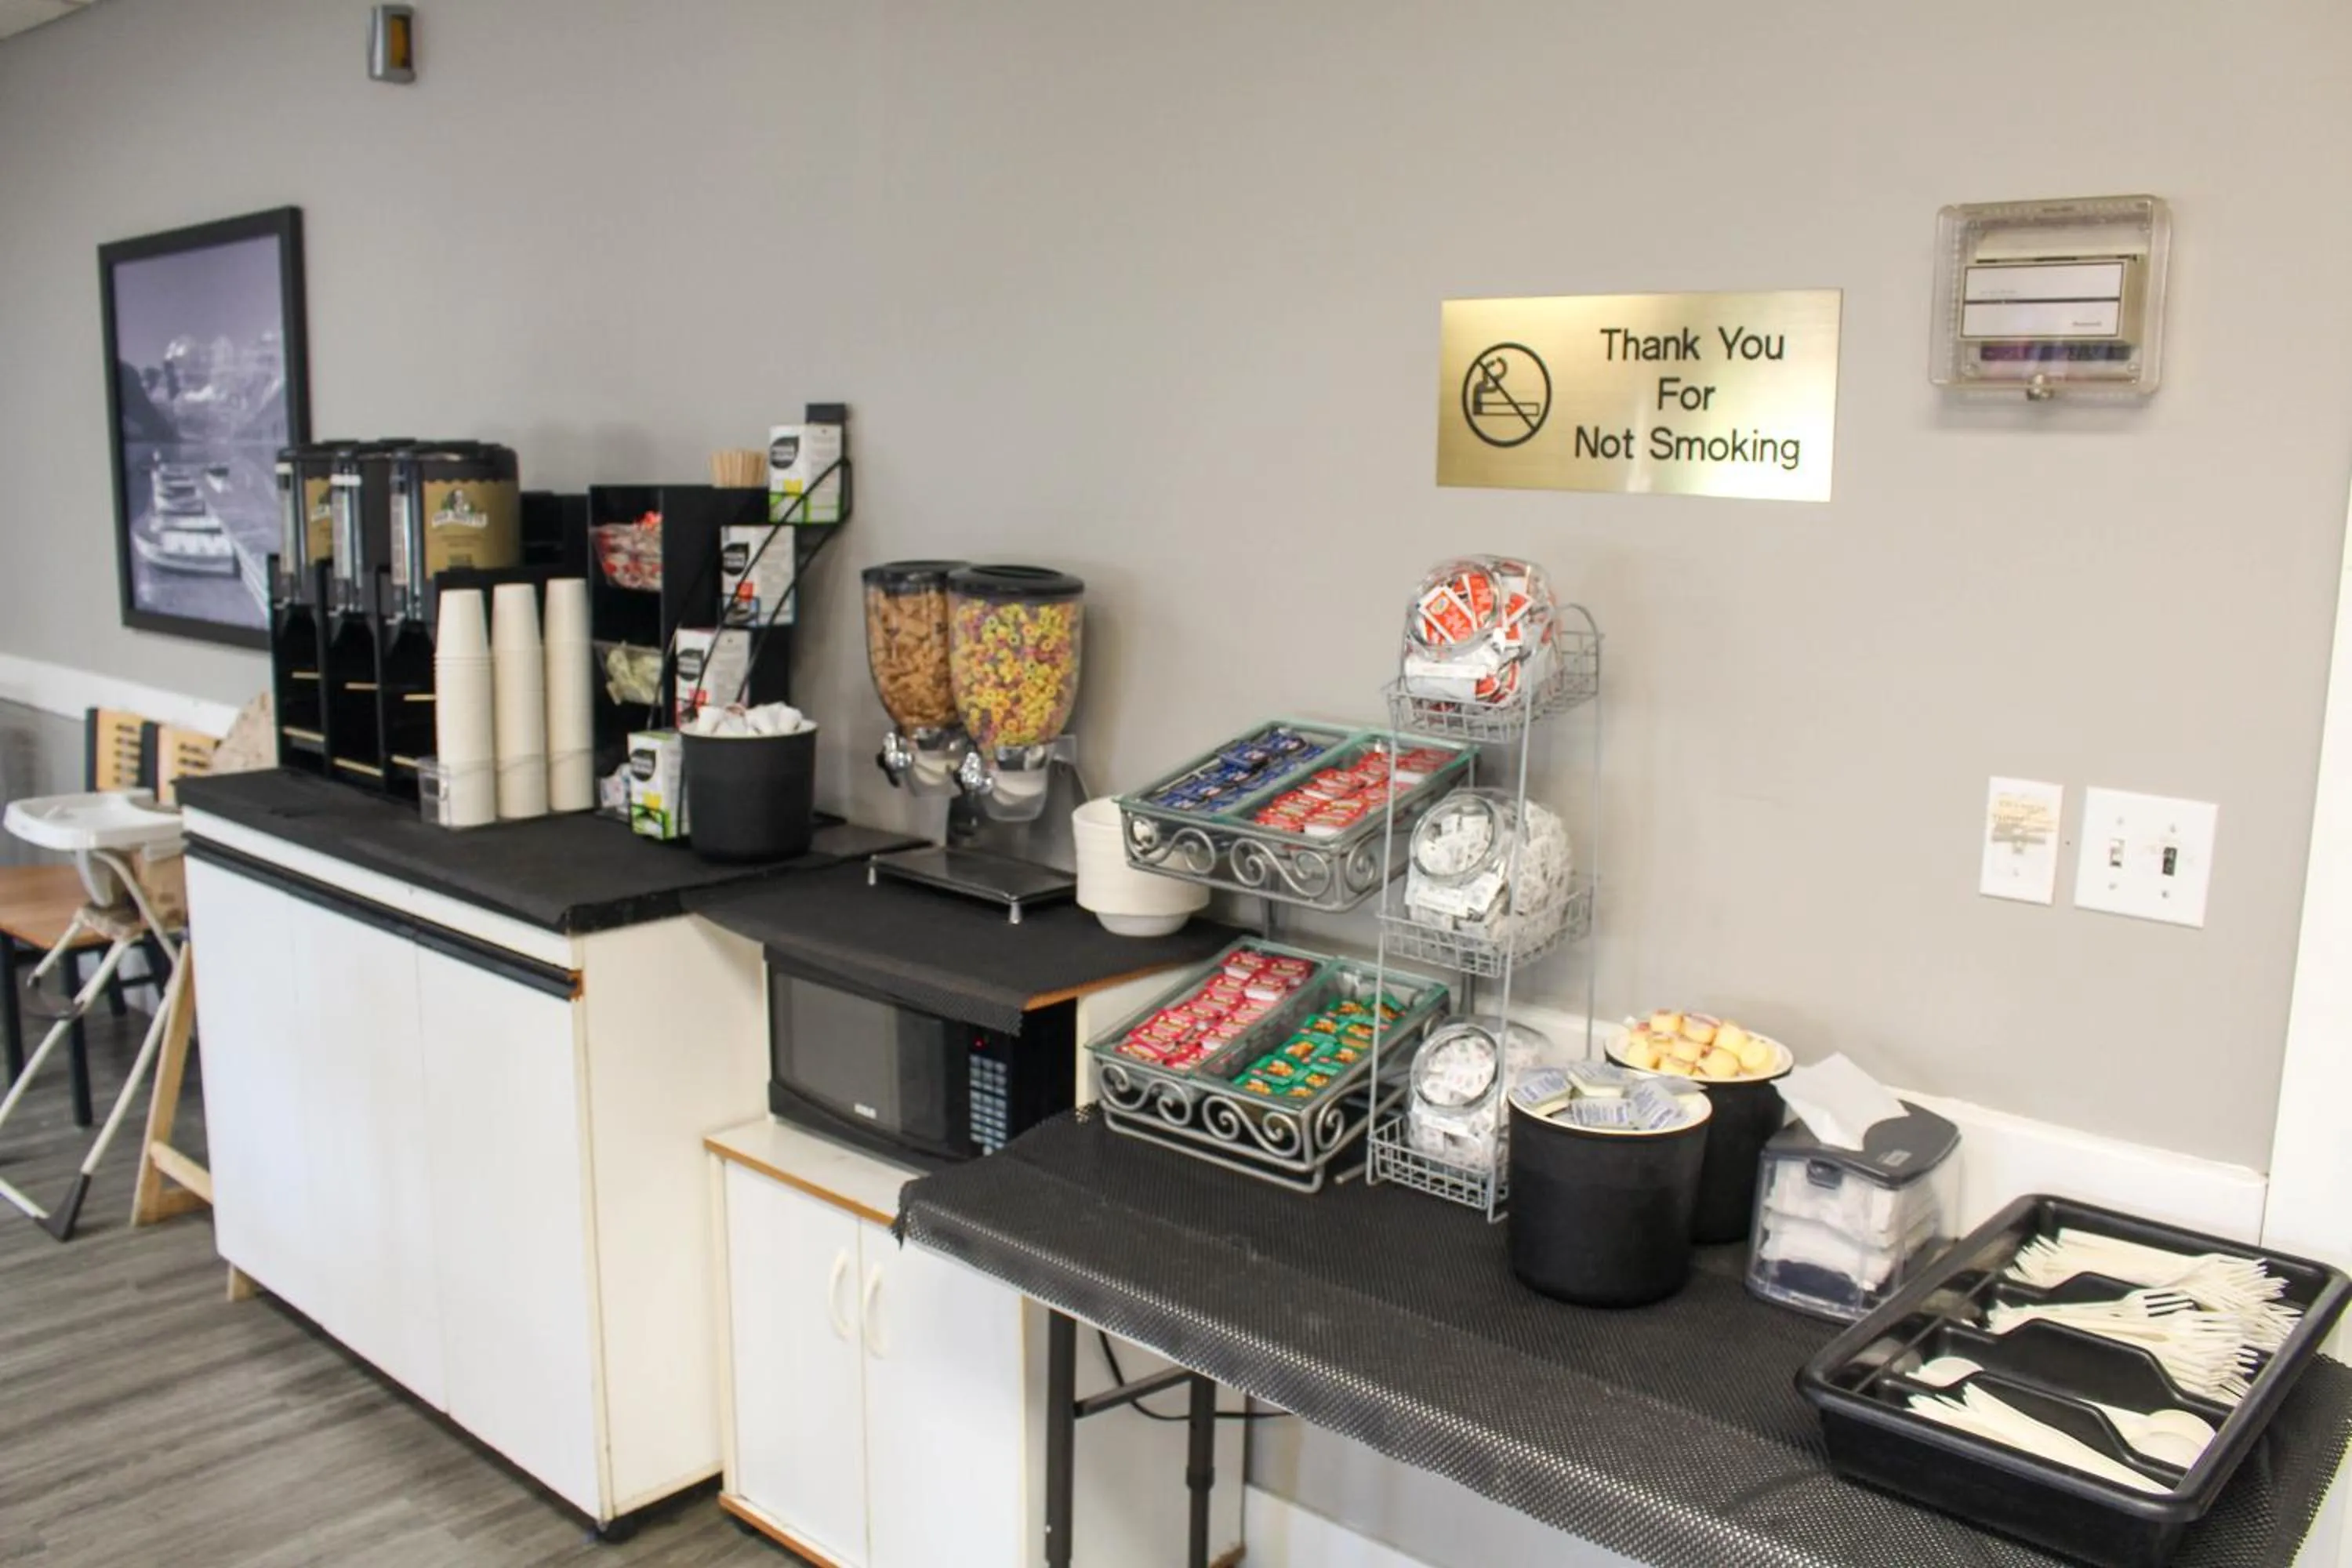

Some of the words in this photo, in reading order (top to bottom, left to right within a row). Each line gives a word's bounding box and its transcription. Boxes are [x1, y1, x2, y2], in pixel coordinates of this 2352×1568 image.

[1599, 326, 1701, 361] Thank
[1718, 325, 1785, 361] You
[1657, 376, 1717, 411] For
[1574, 425, 1635, 460] Not
[1649, 426, 1801, 470] Smoking
